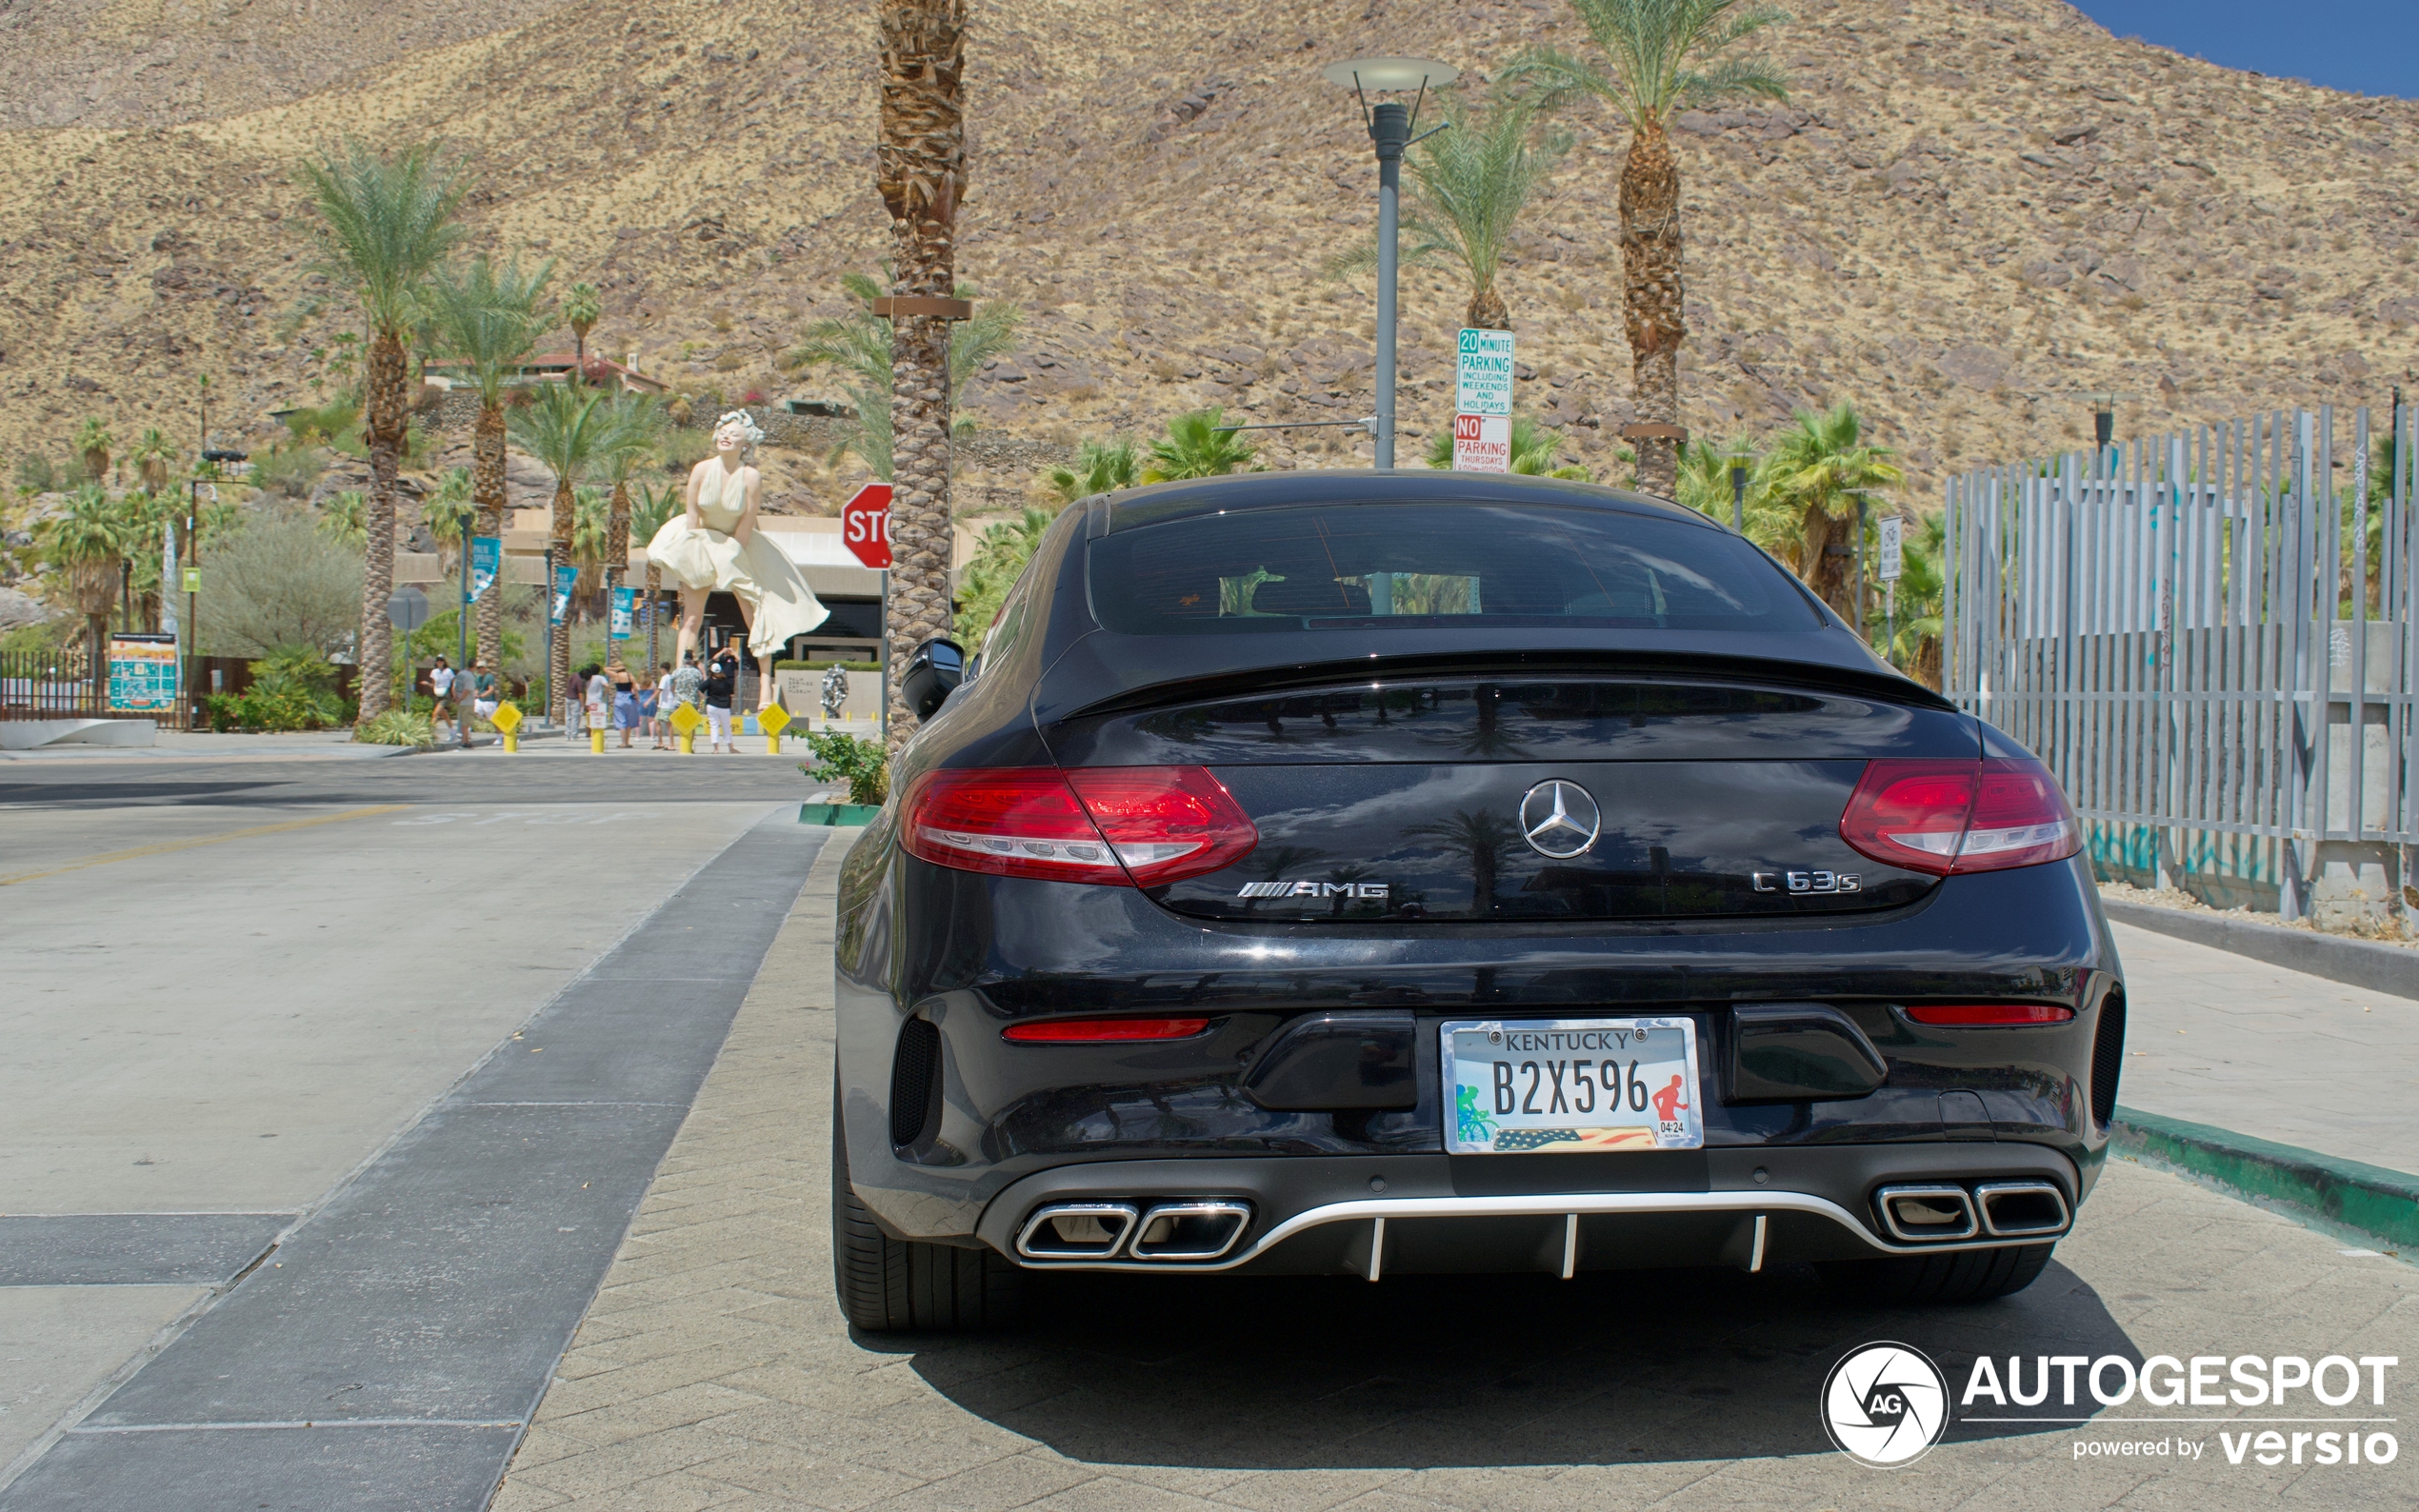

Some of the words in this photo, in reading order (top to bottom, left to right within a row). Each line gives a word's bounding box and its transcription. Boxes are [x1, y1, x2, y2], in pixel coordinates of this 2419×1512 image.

[1460, 331, 1478, 351] 20
[1480, 339, 1510, 353] MINUTE
[1462, 355, 1509, 372] PARKING
[1463, 372, 1508, 382] INCLUDING
[1462, 381, 1509, 391] WEEKENDS
[1475, 391, 1494, 400] AND
[1463, 400, 1506, 410] HOLIDAYS
[1458, 418, 1479, 438] NO
[1458, 442, 1507, 456] PARKING
[1461, 454, 1504, 466] THURSDAYS
[848, 510, 895, 543] STO
[1285, 882, 1389, 899] AMG
[1752, 872, 1776, 892] C
[1506, 1032, 1629, 1051] KENTUCKY
[1492, 1059, 1649, 1115] B2X596
